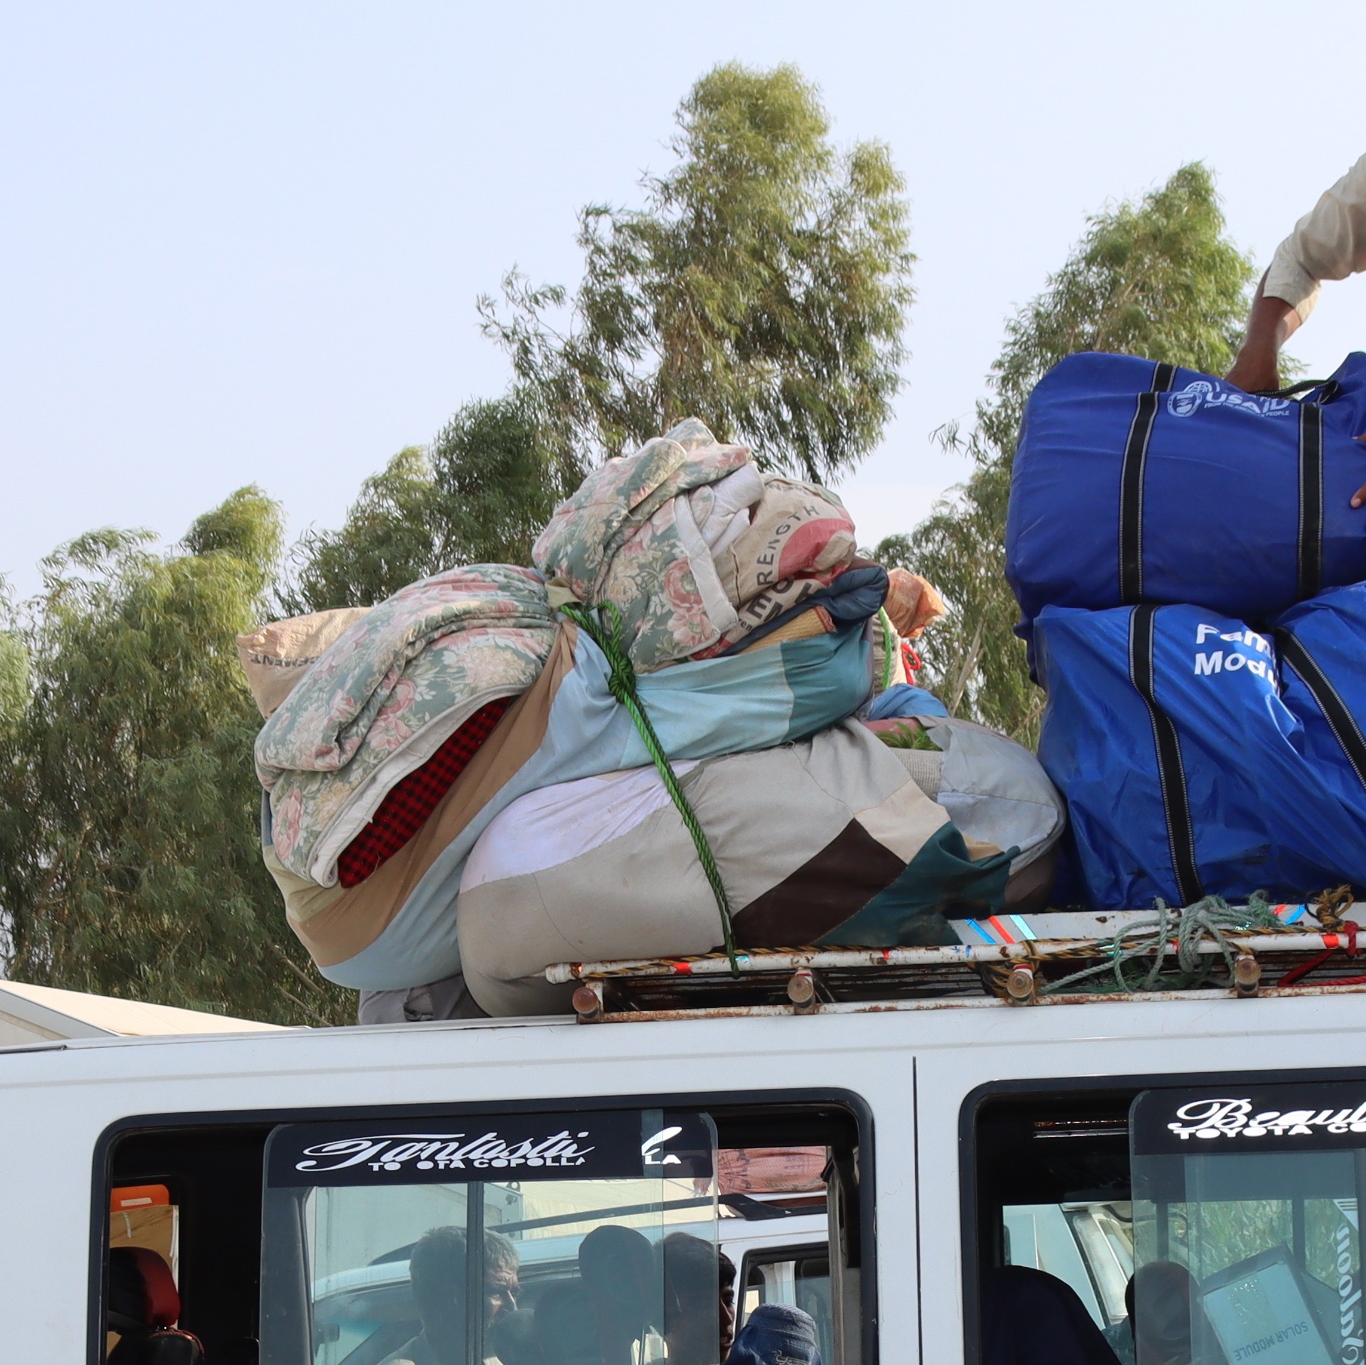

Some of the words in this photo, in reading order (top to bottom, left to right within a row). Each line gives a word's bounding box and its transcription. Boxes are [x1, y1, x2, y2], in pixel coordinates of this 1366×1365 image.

[1196, 623, 1273, 661] Fam
[1275, 1321, 1308, 1344] SOLAR
[1233, 1335, 1275, 1362] MODULE
